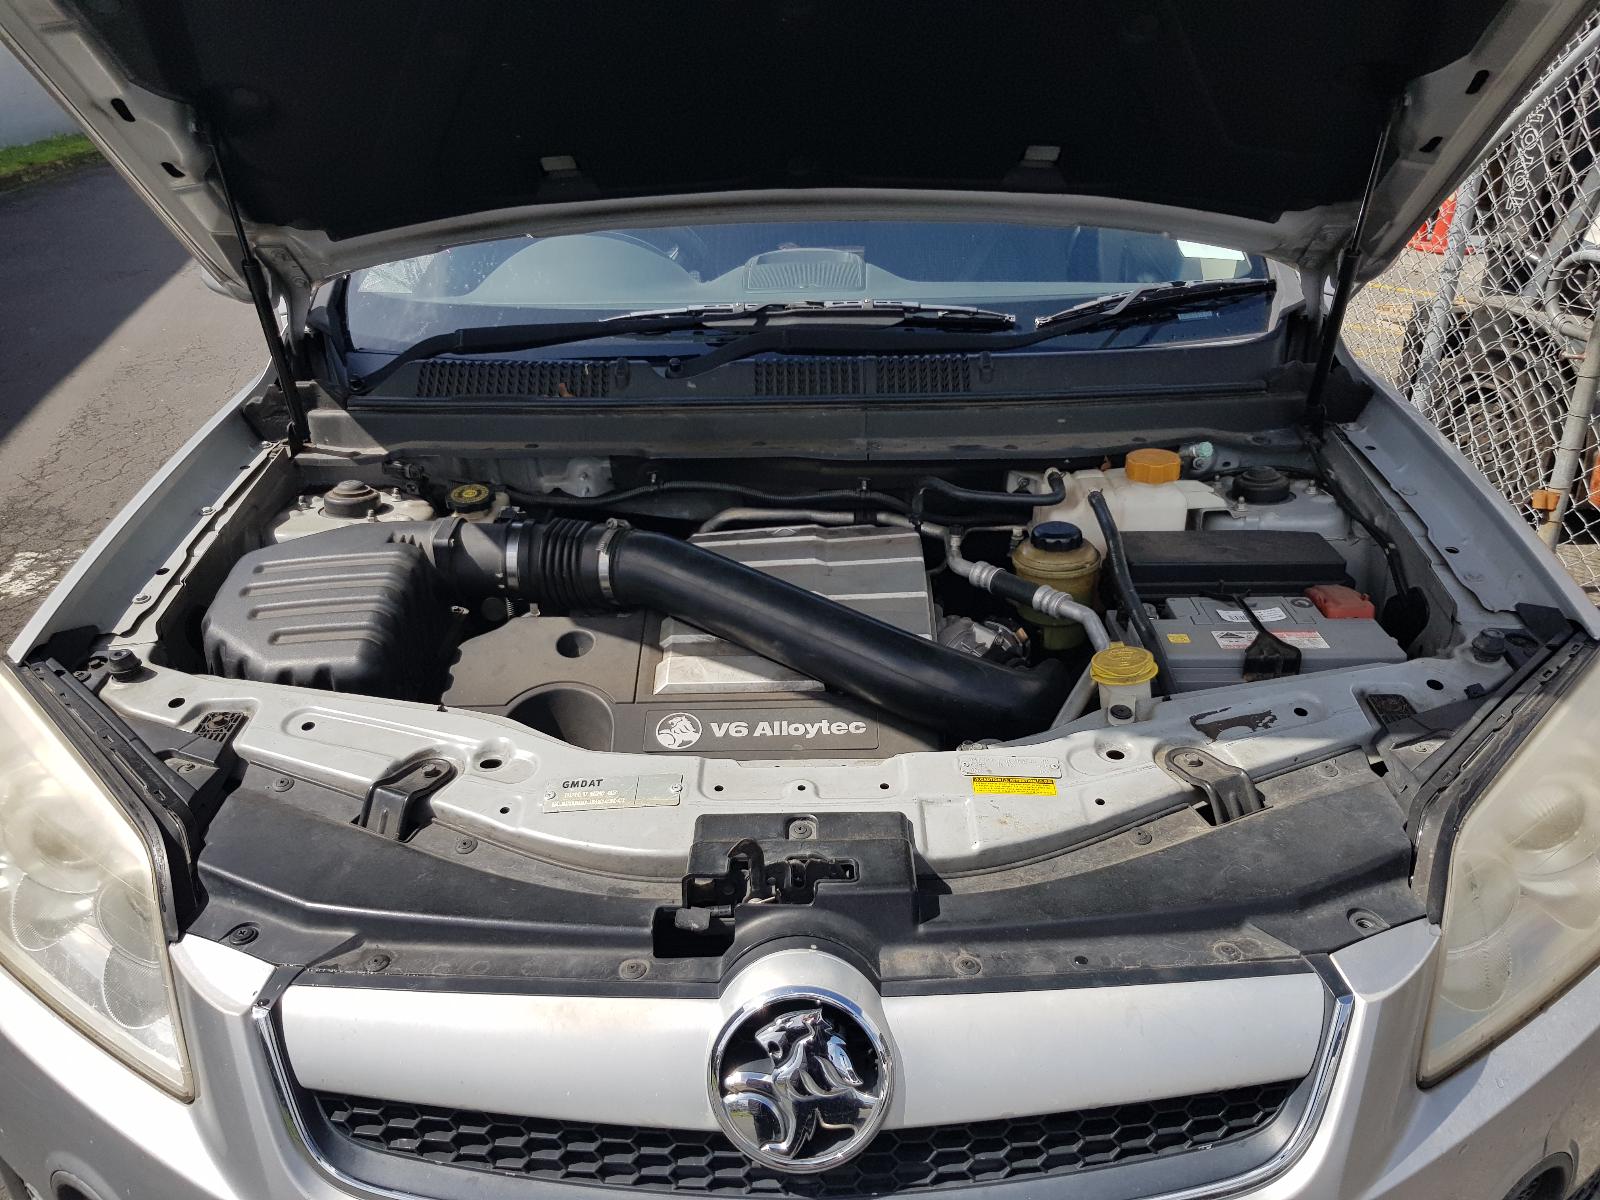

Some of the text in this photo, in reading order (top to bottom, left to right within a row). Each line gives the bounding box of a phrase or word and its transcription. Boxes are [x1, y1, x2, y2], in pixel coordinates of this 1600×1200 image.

[1505, 107, 1545, 210] TOYOT
[710, 719, 867, 739] V6 Alloytec
[562, 779, 604, 789] GMDAT
